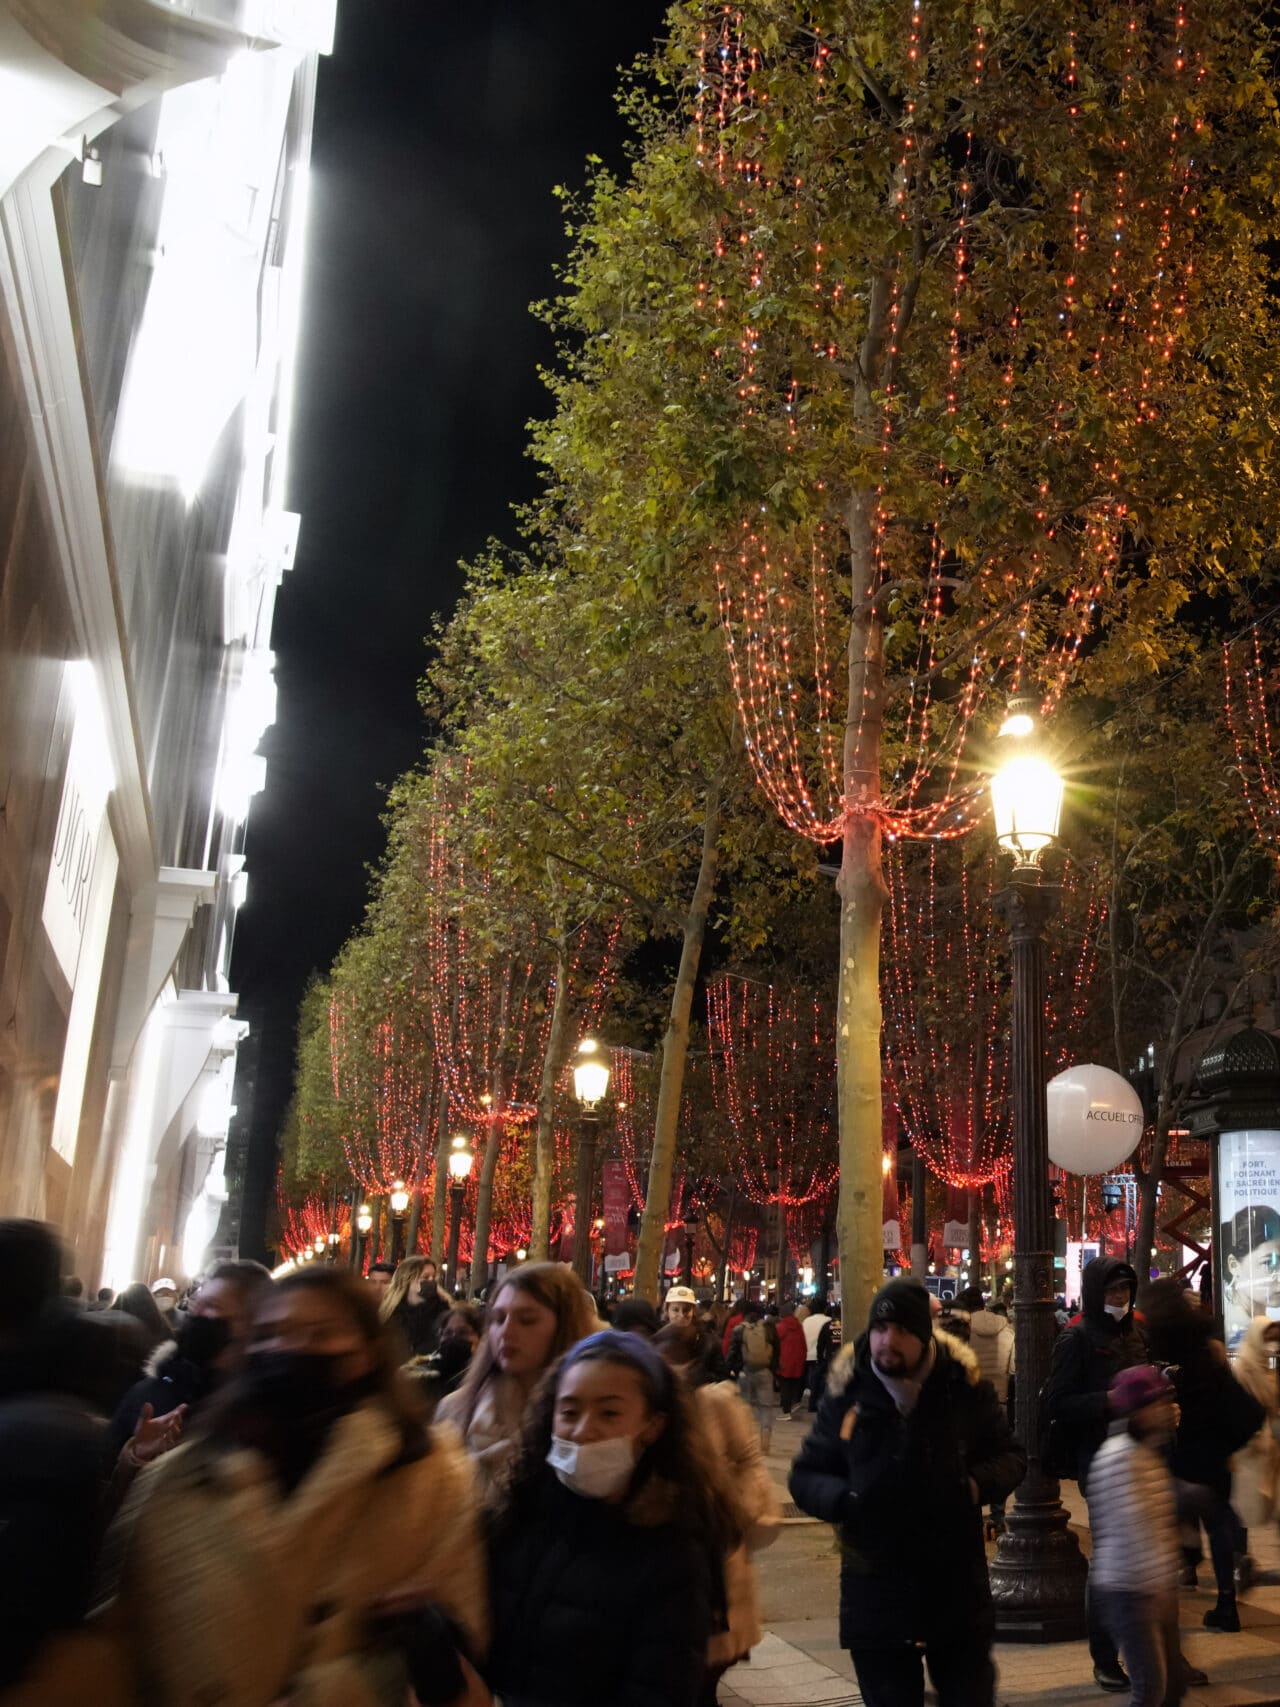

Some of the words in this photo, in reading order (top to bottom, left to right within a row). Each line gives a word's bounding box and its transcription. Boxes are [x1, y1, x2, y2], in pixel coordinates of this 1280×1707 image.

[54, 777, 93, 934] DIOR
[1087, 1110, 1126, 1122] ACCUEIL
[1234, 1169, 1276, 1178] POIGNANT
[1234, 1188, 1278, 1197] POLITIQUE
